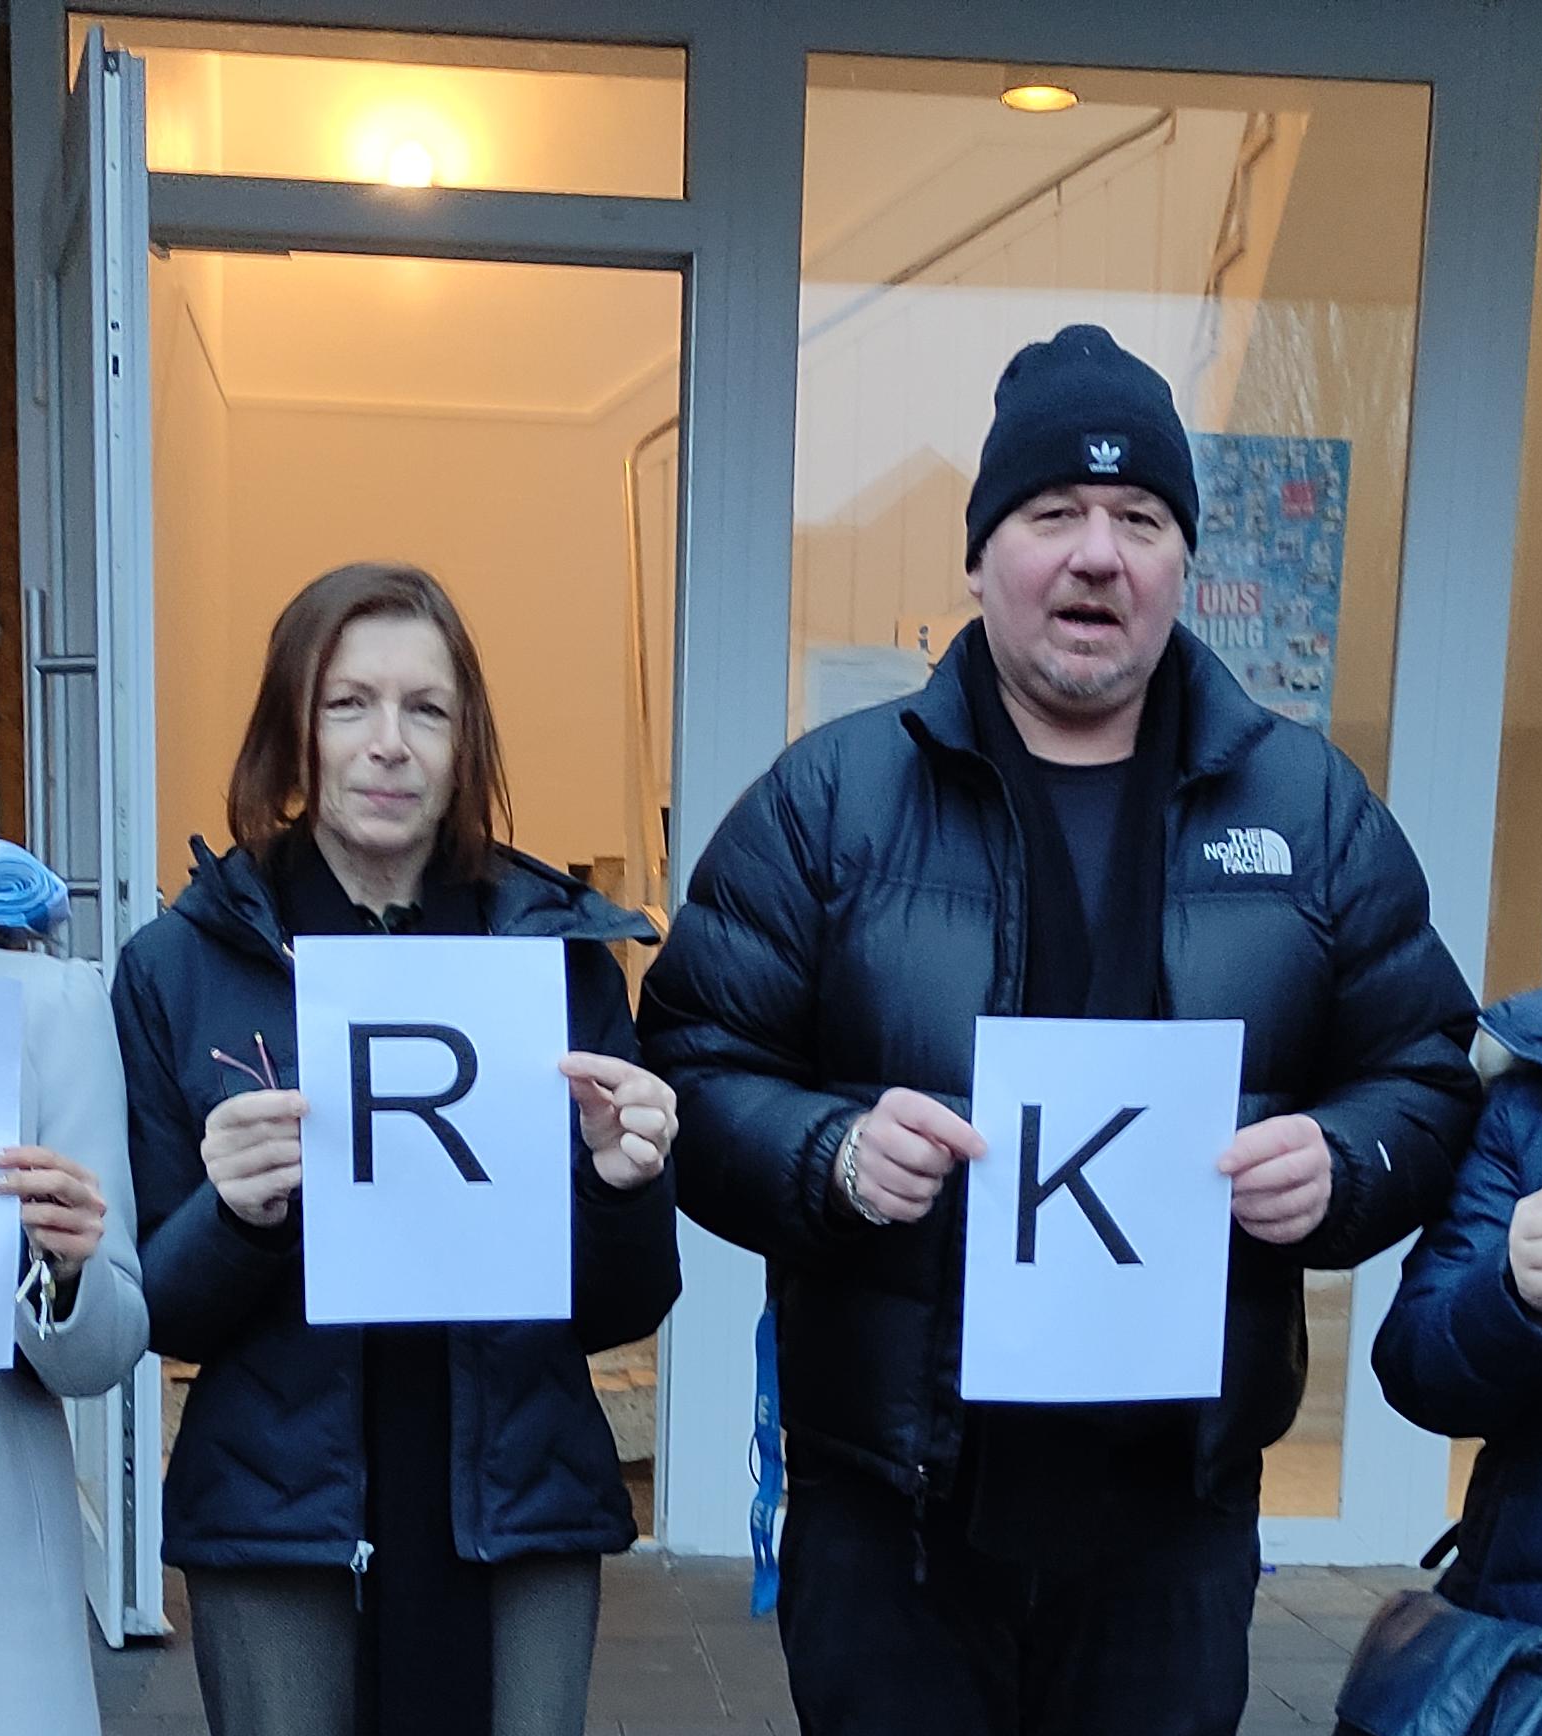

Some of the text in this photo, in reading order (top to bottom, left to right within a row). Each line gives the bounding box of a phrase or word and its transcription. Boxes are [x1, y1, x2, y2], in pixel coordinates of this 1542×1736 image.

[1202, 583, 1258, 614] UNS
[1226, 828, 1261, 845] THE
[1203, 842, 1262, 860] NORTH
[1222, 857, 1265, 874] FACE
[348, 1022, 493, 1184] R
[1015, 1103, 1149, 1265] K
